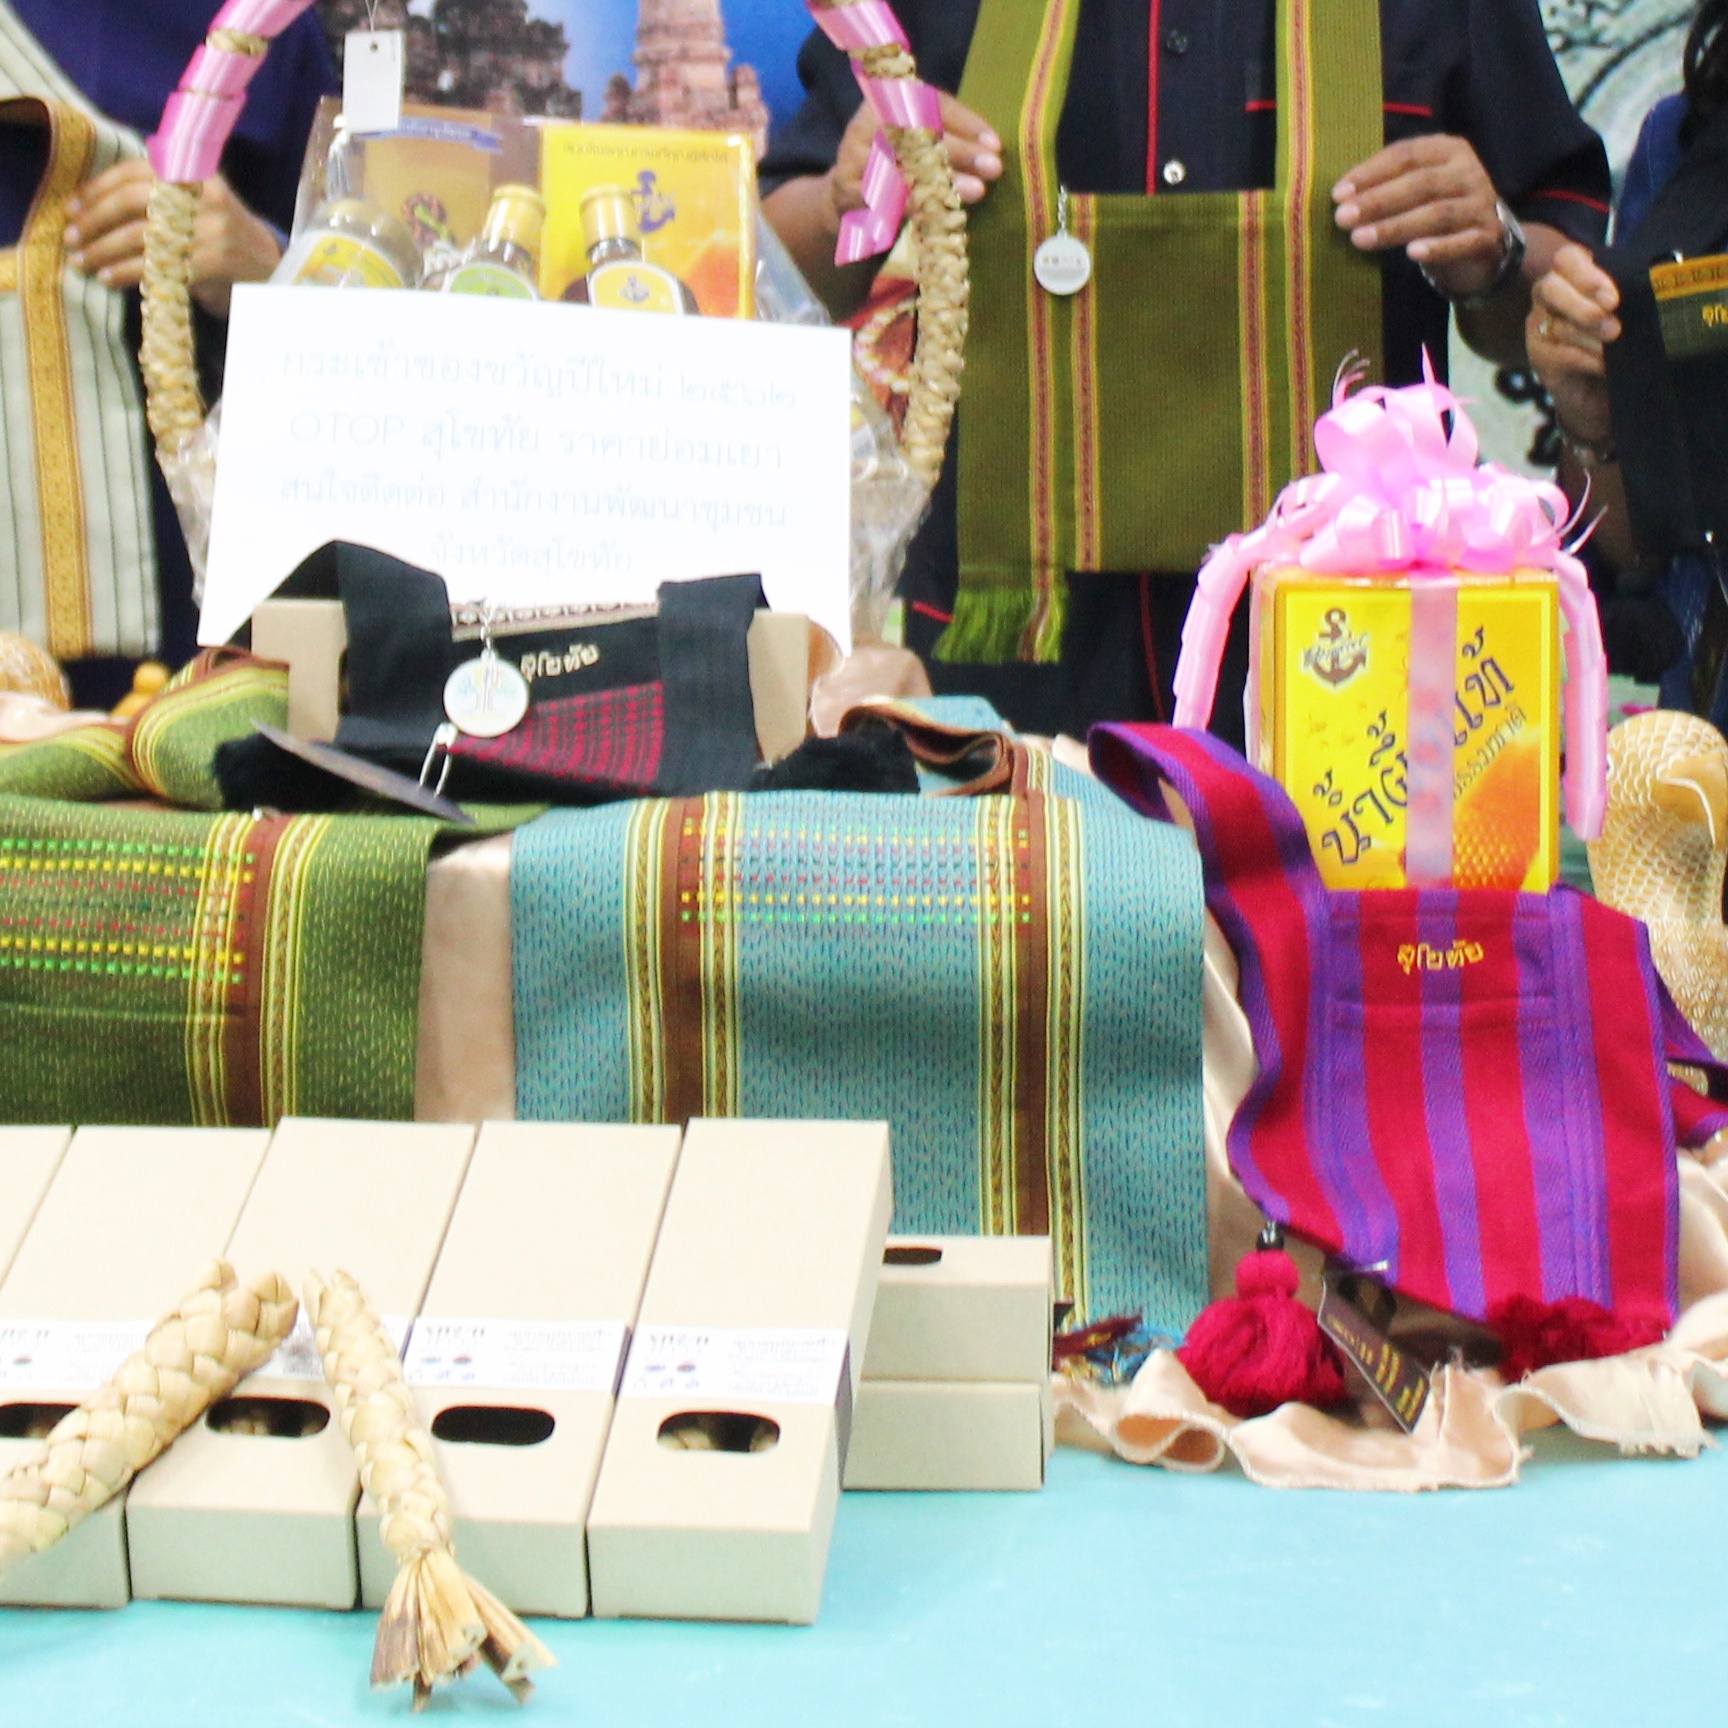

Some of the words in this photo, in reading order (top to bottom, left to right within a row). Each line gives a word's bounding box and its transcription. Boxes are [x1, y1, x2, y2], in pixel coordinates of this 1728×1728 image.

[282, 338, 664, 402] กระเช้าของขวัญปีใหม่
[679, 374, 798, 409] ๒๕๖๒
[290, 411, 405, 448] OTOP
[421, 409, 540, 462] สุโขทัย
[558, 424, 783, 471] ราคาย่อมเยา
[279, 470, 447, 508] สนใจติดต่อ
[460, 478, 787, 534] สำนักงานพัฒนาชุมชน
[430, 534, 634, 581] จังหวัดสุโขทัย
